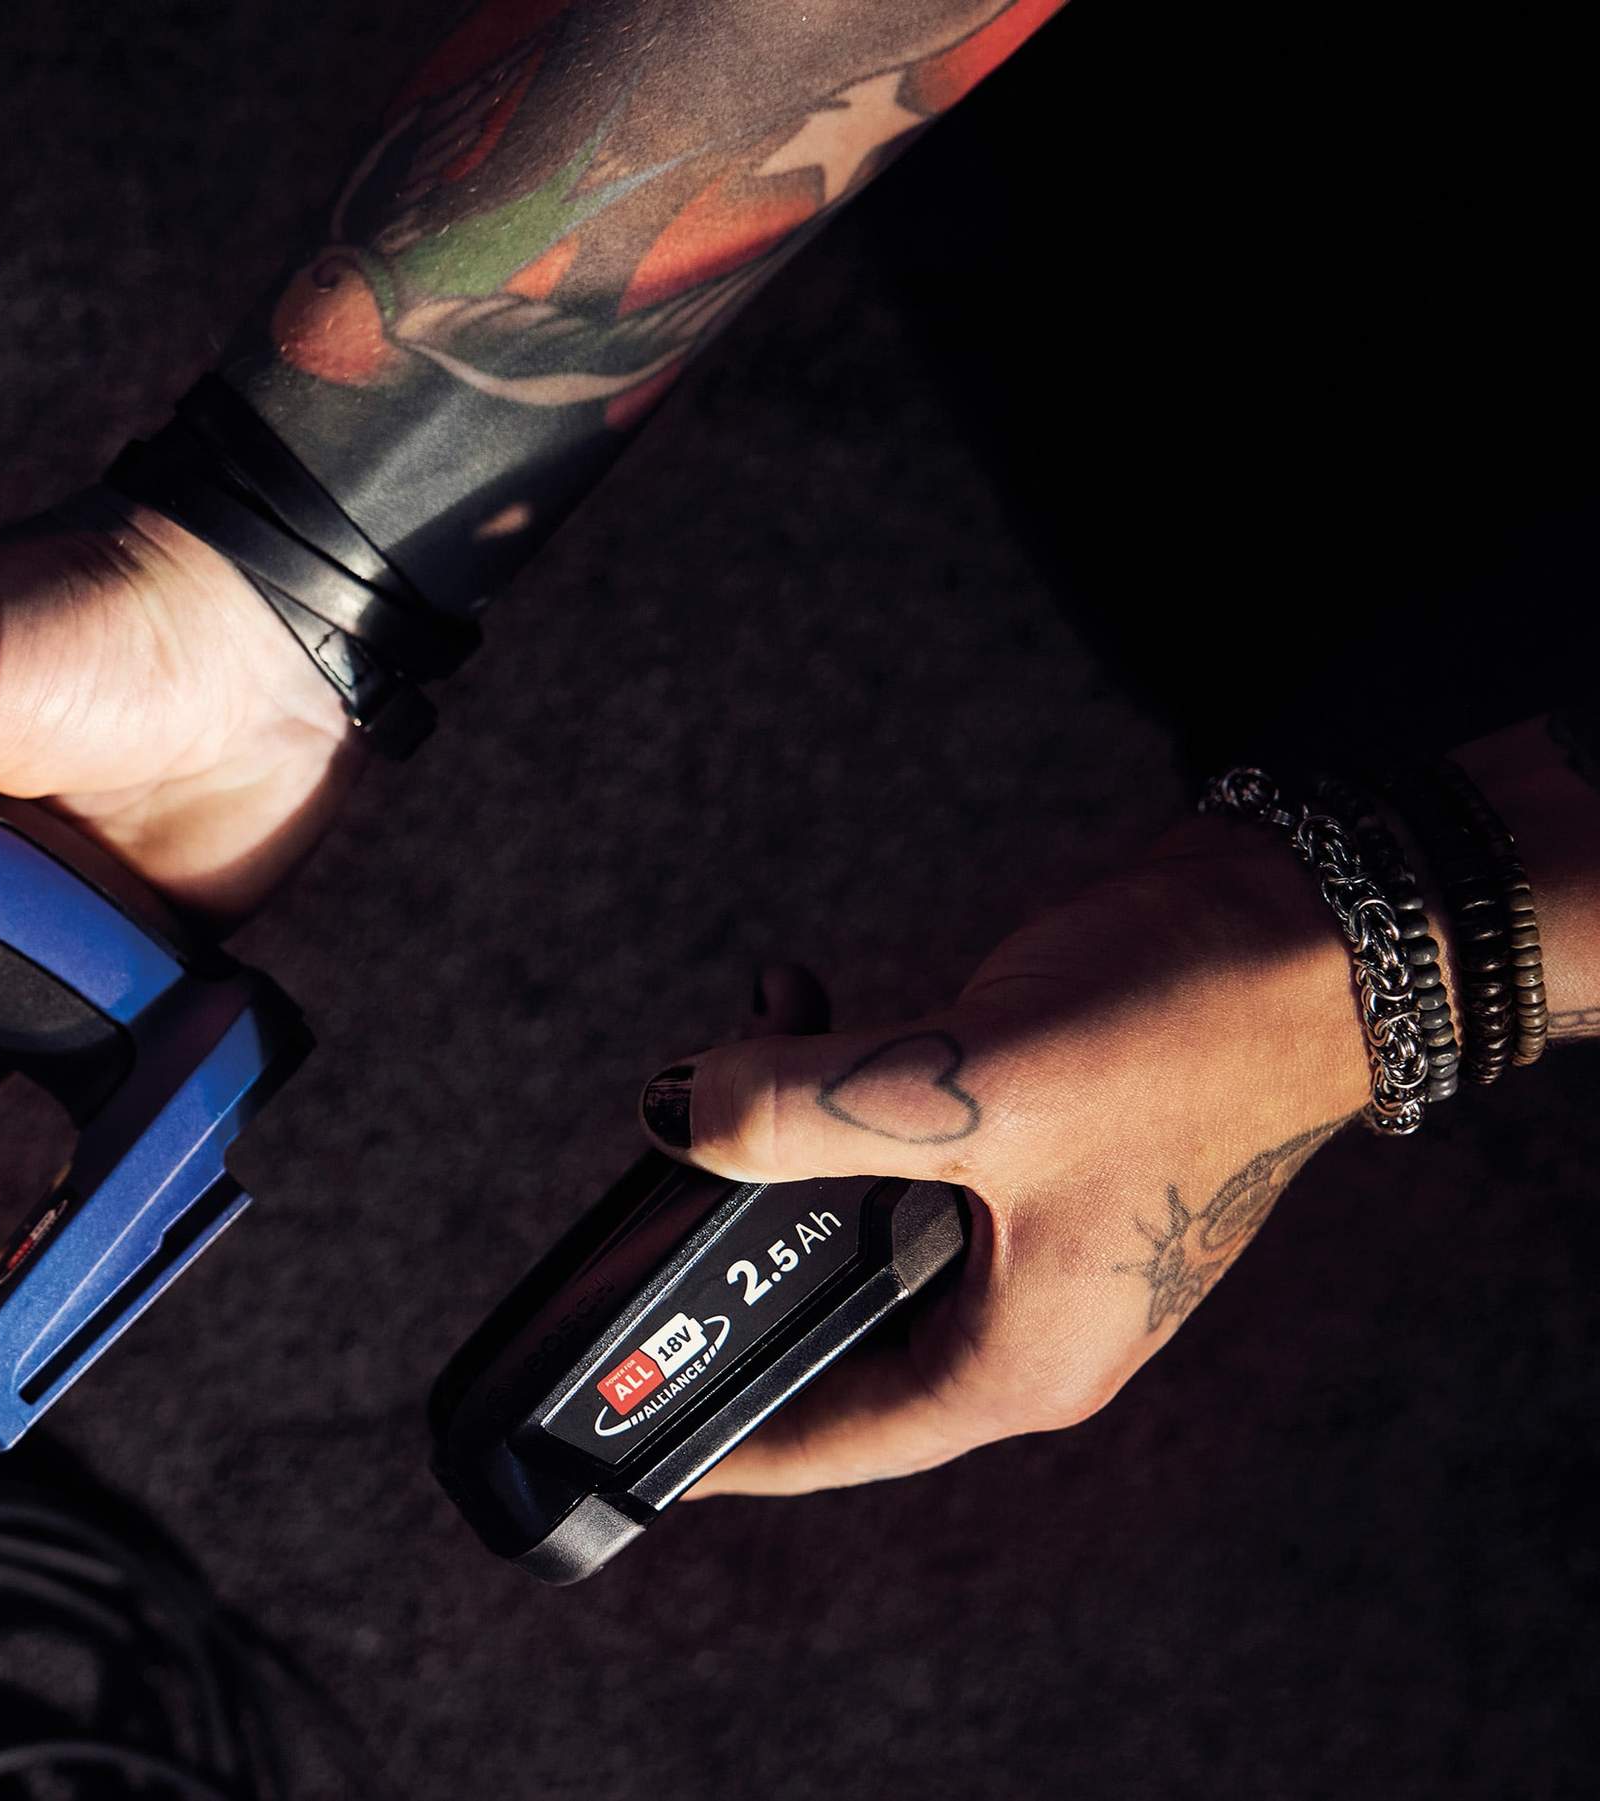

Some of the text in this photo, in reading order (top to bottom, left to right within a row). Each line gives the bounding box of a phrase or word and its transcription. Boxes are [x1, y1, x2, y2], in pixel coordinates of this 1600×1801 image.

[726, 1208, 843, 1307] 2.5 Ah
[657, 1325, 692, 1362] 18V
[614, 1365, 655, 1402] ALL
[643, 1359, 707, 1419] ALLIANCE
